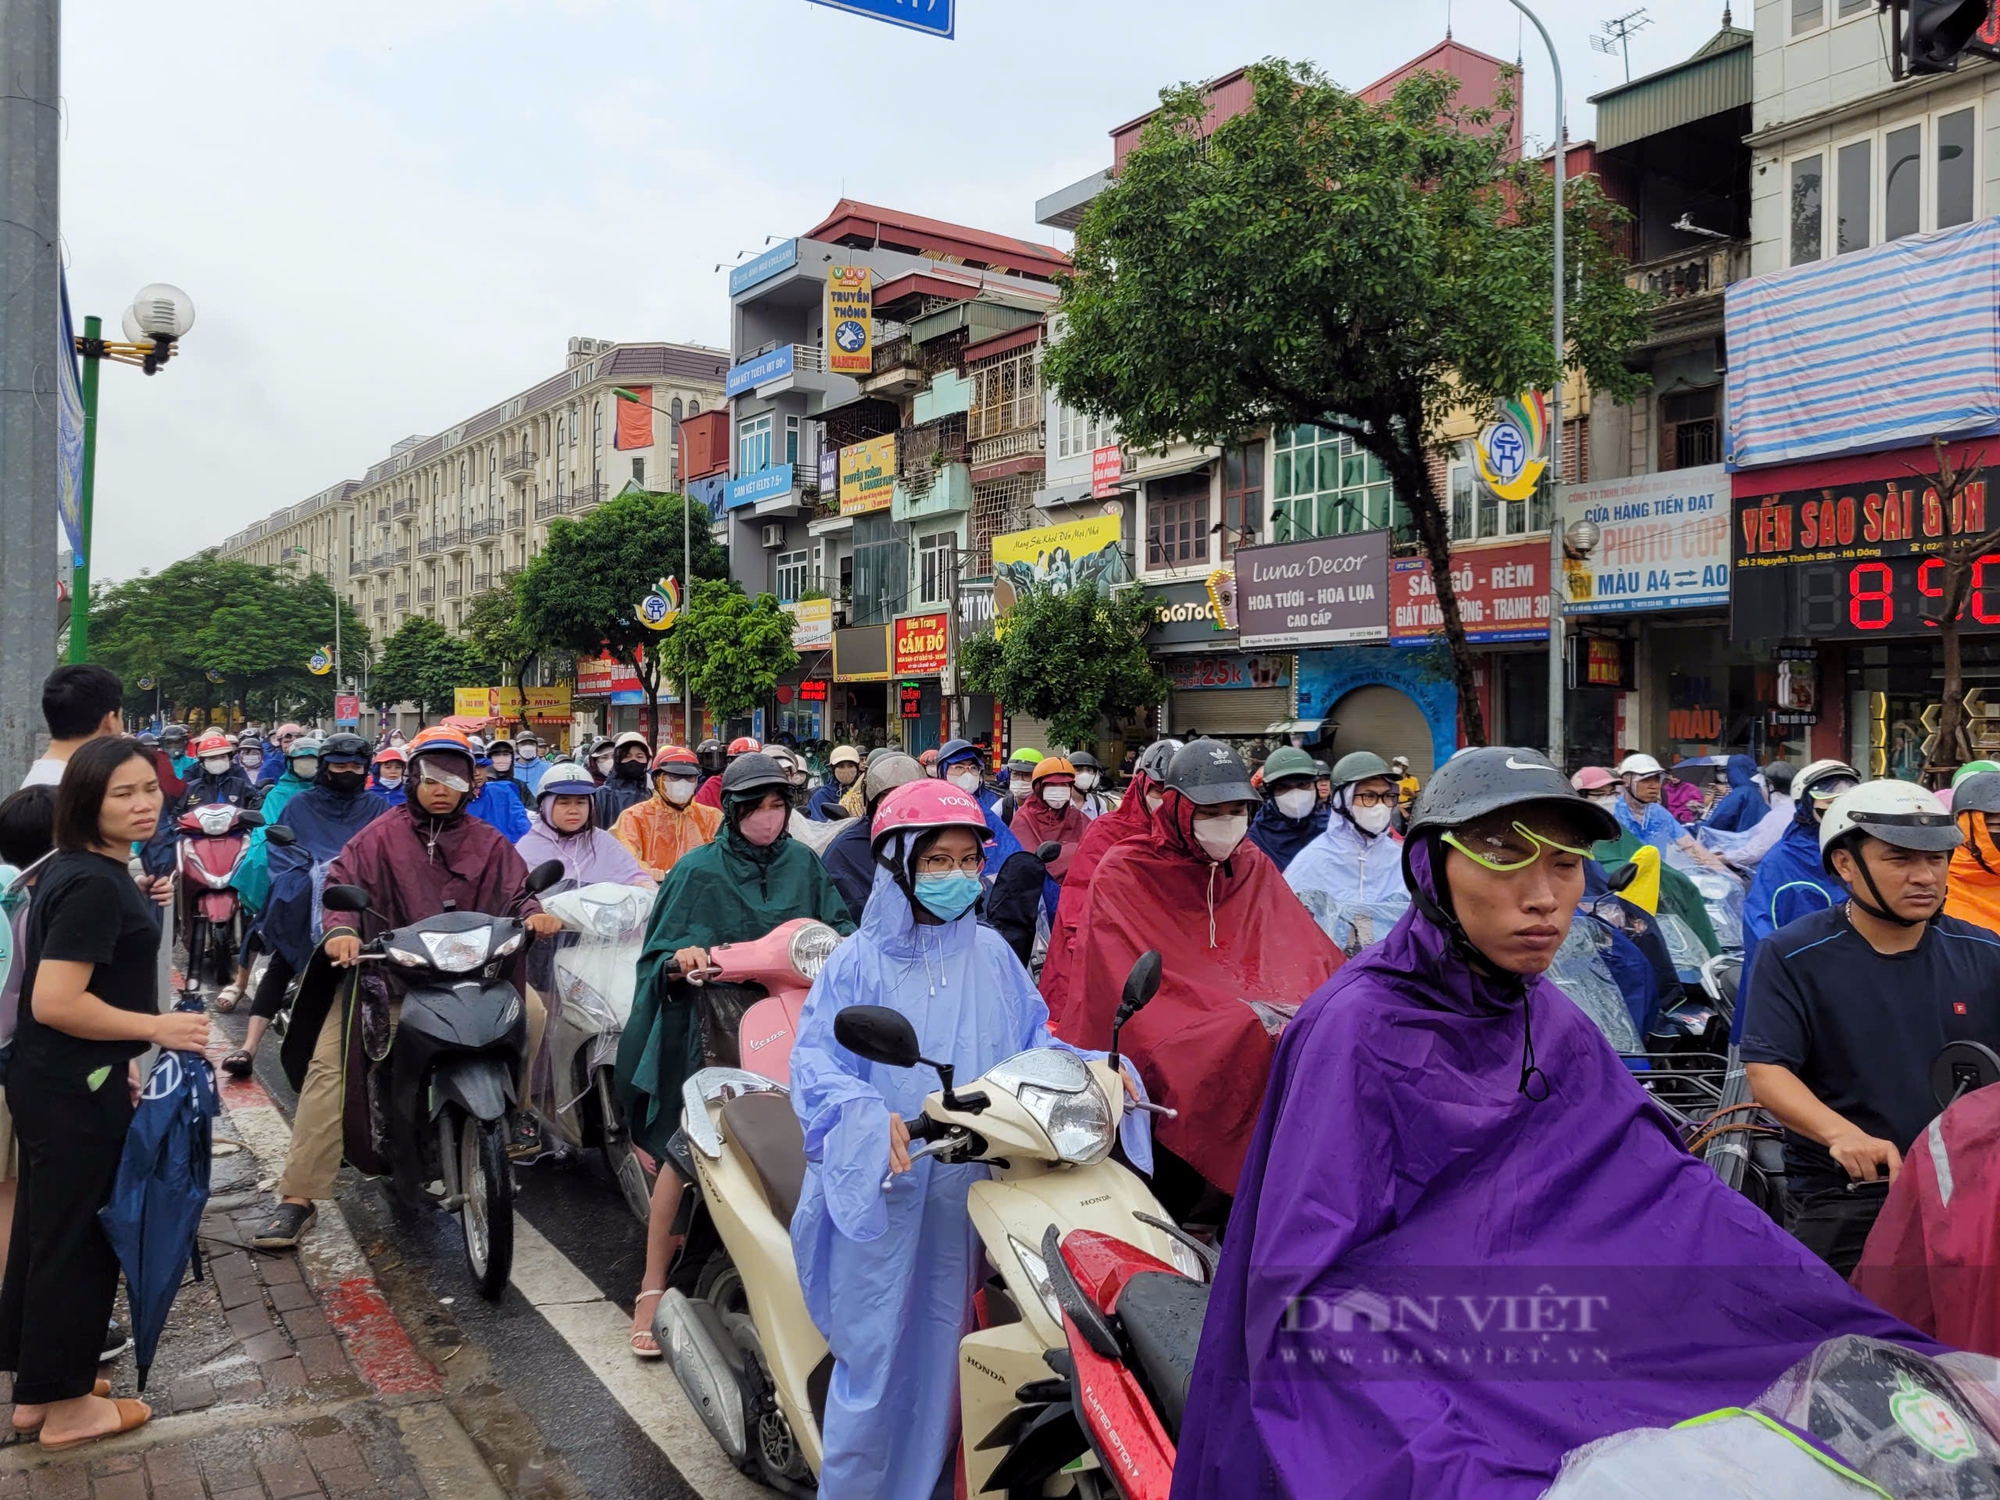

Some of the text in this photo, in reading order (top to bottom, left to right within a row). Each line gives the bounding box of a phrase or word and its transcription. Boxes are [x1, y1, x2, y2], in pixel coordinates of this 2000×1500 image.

[831, 288, 870, 304] TRUYỀN
[834, 305, 867, 318] THÔNG
[831, 355, 870, 370] MARKETING
[821, 457, 835, 474] BÁN
[820, 474, 834, 492] NHÀ
[1590, 490, 1598, 501] TY
[1585, 494, 1714, 523] CỬA HÀNG TIẾN ĐẠT
[1742, 495, 1793, 554] YẾN
[1800, 490, 1855, 549] SÀO
[1863, 482, 1914, 542] SÀI
[1013, 541, 1030, 551] Mang
[1603, 522, 1673, 567] PHOTO
[1405, 561, 1423, 569] HOME
[1738, 557, 1750, 568] Số
[1750, 558, 1757, 566] 2
[1789, 553, 1815, 563] Thanh
[1843, 549, 1855, 558] Hà
[1856, 547, 1881, 558] Đông
[1253, 555, 1368, 583] Luna Decor
[1450, 563, 1474, 593] GỖ
[1491, 562, 1534, 590] RÈM
[1598, 569, 1640, 596] MÀU
[1646, 569, 1671, 592] A4
[1248, 595, 1273, 611] HOA
[1275, 590, 1305, 608] TƯƠI
[1317, 588, 1345, 604] HOA
[1348, 584, 1375, 604] LỤA
[1287, 608, 1332, 628] CAO CẤP
[1396, 598, 1419, 627] GIẤY
[1493, 597, 1531, 621] TRANH
[1534, 595, 1550, 618] 3D
[920, 617, 937, 630] Trang
[535, 697, 560, 706] MINH
[1669, 703, 1722, 739] MÀU
[938, 796, 982, 813] YOONA
[1080, 1194, 1112, 1206] HONDA
[966, 1355, 1007, 1385] HONDA
[1087, 1391, 1135, 1470] LIMITED EDITION
